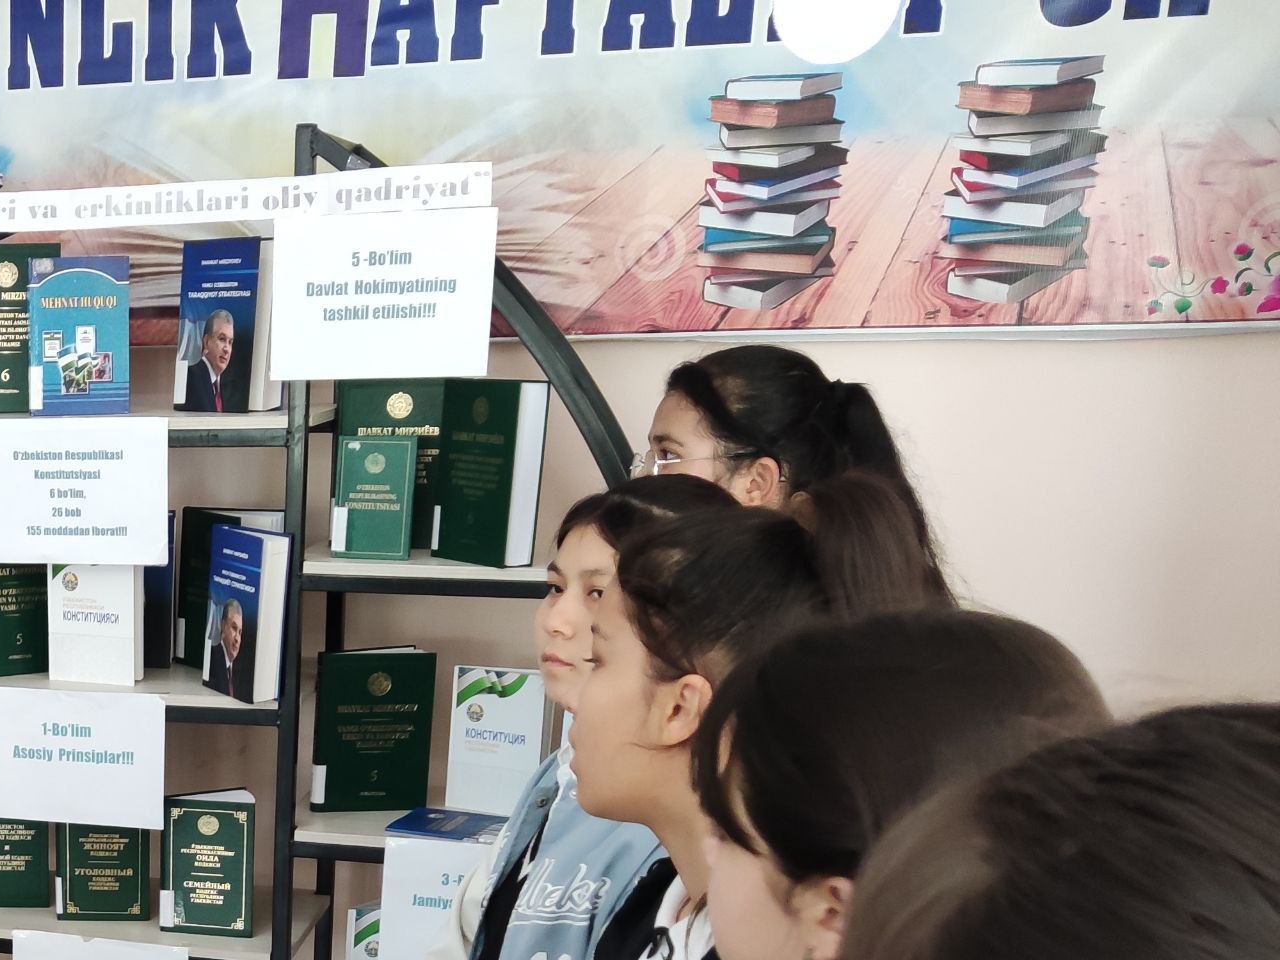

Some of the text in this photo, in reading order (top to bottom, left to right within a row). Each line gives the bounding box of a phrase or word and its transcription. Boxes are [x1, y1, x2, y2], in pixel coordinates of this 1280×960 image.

[28, 203, 58, 220] va
[75, 186, 249, 220] erkinliklari
[262, 186, 319, 213] oliy
[306, 276, 457, 297] Davlat Hokimyatining
[41, 295, 118, 310] MEHNAT HUQUQI
[323, 303, 437, 321] tashkil etilishi!!!
[1, 370, 10, 382] 6
[64, 450, 123, 462] Respublikasi
[34, 469, 101, 480] Konstitutsiyasi
[49, 488, 55, 499] 6
[51, 507, 82, 518] 26 bob
[26, 526, 42, 536] 155
[43, 526, 90, 537] moddadan
[62, 610, 120, 624] КОНСТИТУЦИЯСИ
[16, 633, 23, 645] 5
[465, 727, 526, 745] КОНСТИТУЦИЯ
[13, 745, 134, 765] Asosiy Prinsiplar!!!
[83, 842, 125, 851] ЖИНОЯТ
[74, 867, 134, 877] УГОЛОВНЫЙ
[183, 880, 232, 891] СЕМЕЙНЫЙ
[441, 873, 450, 886] 3
